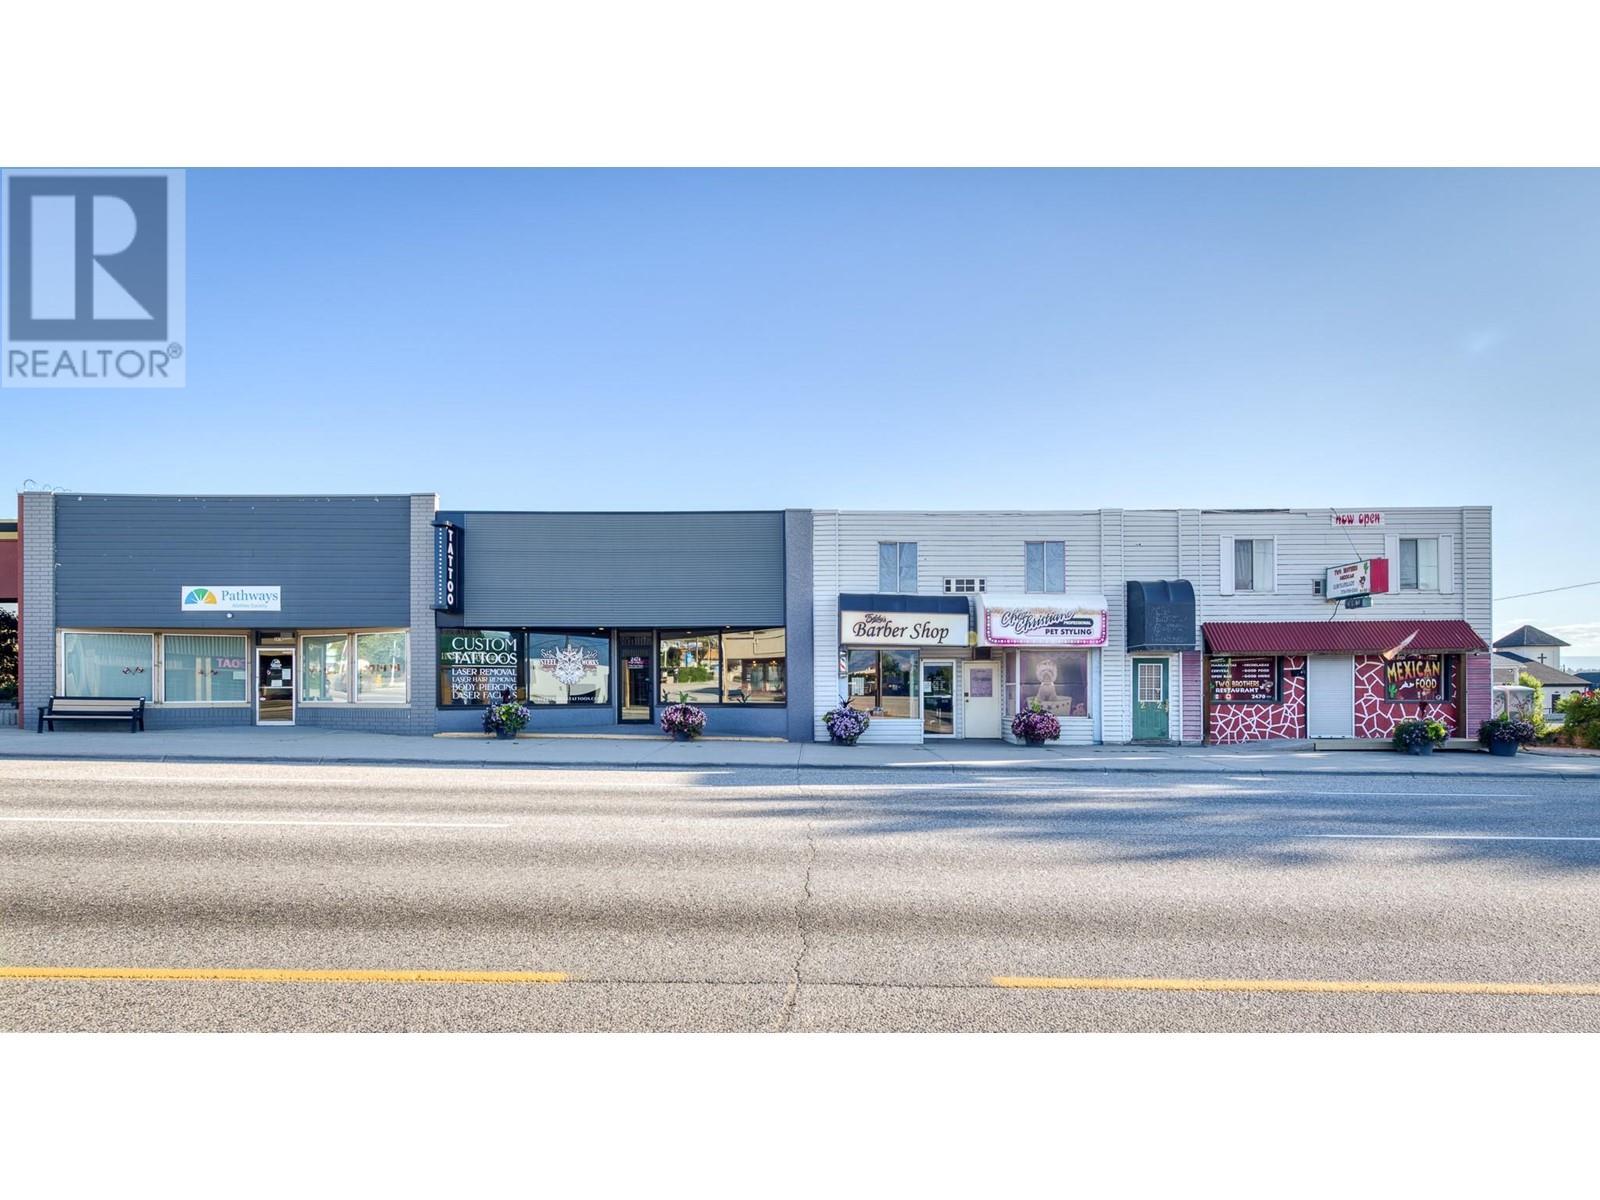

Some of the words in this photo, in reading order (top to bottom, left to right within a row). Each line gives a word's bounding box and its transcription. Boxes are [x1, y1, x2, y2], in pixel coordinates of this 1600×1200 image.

[221, 589, 279, 604] Pathways
[852, 620, 908, 637] Barber
[910, 621, 949, 644] Shop
[451, 637, 517, 652] CUSTOM
[452, 651, 518, 665] TATTOOS
[451, 668, 477, 676] LASER
[479, 668, 517, 676] REMOVAL
[1387, 660, 1441, 683] MEXICAN
[451, 683, 476, 691] BODY
[479, 683, 517, 692] PIERCING
[1215, 680, 1231, 688] TWO
[1231, 680, 1260, 688] BROTHERS
[1415, 678, 1437, 689] FOOD
[452, 691, 480, 700] LASER
[483, 691, 518, 700] FACIS
